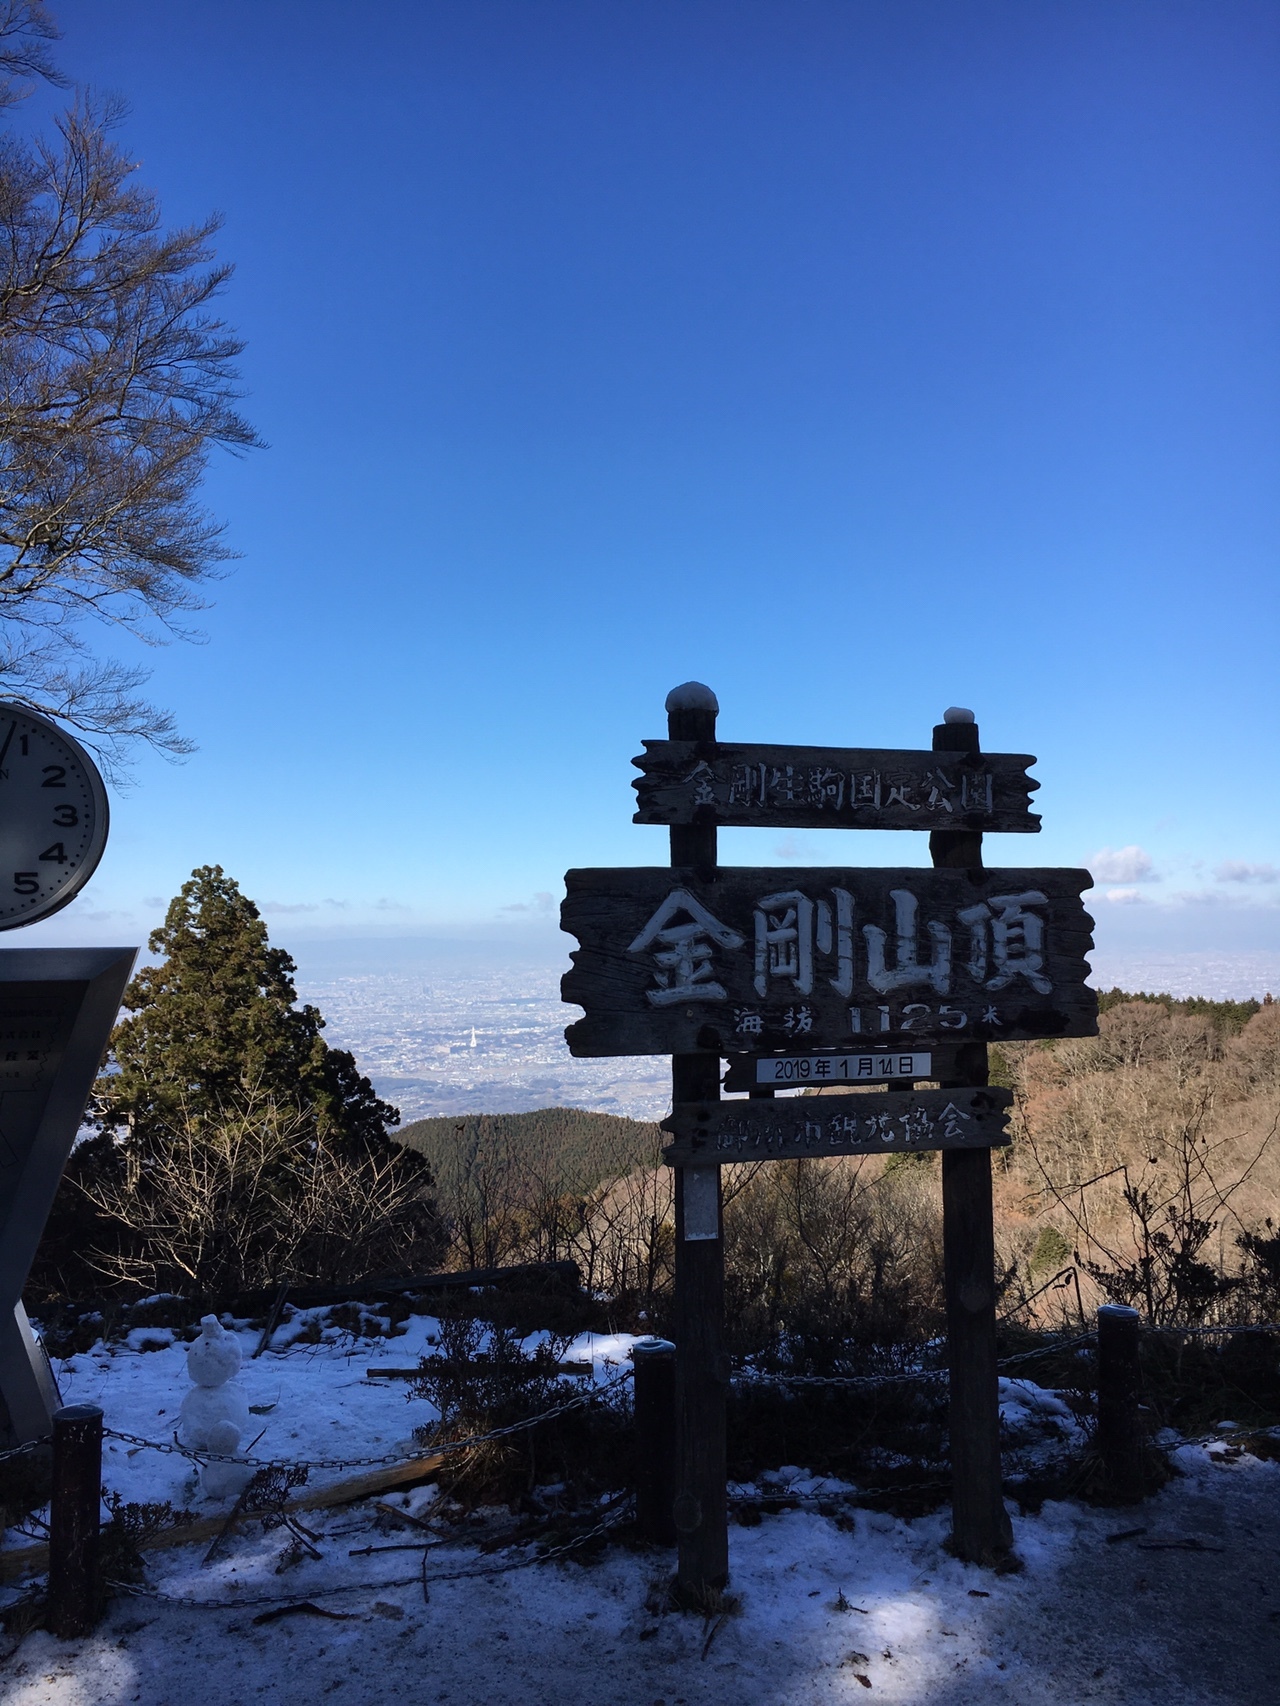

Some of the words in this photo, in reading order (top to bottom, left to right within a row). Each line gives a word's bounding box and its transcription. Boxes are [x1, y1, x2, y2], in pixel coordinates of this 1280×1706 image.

[20, 734, 28, 756] 1
[41, 765, 66, 788] 2
[681, 760, 993, 814] 金剛生駒国定公園
[53, 804, 78, 828] 3
[39, 842, 68, 865] 4
[13, 872, 39, 896] 5
[624, 887, 1053, 1006] 金剛山頂
